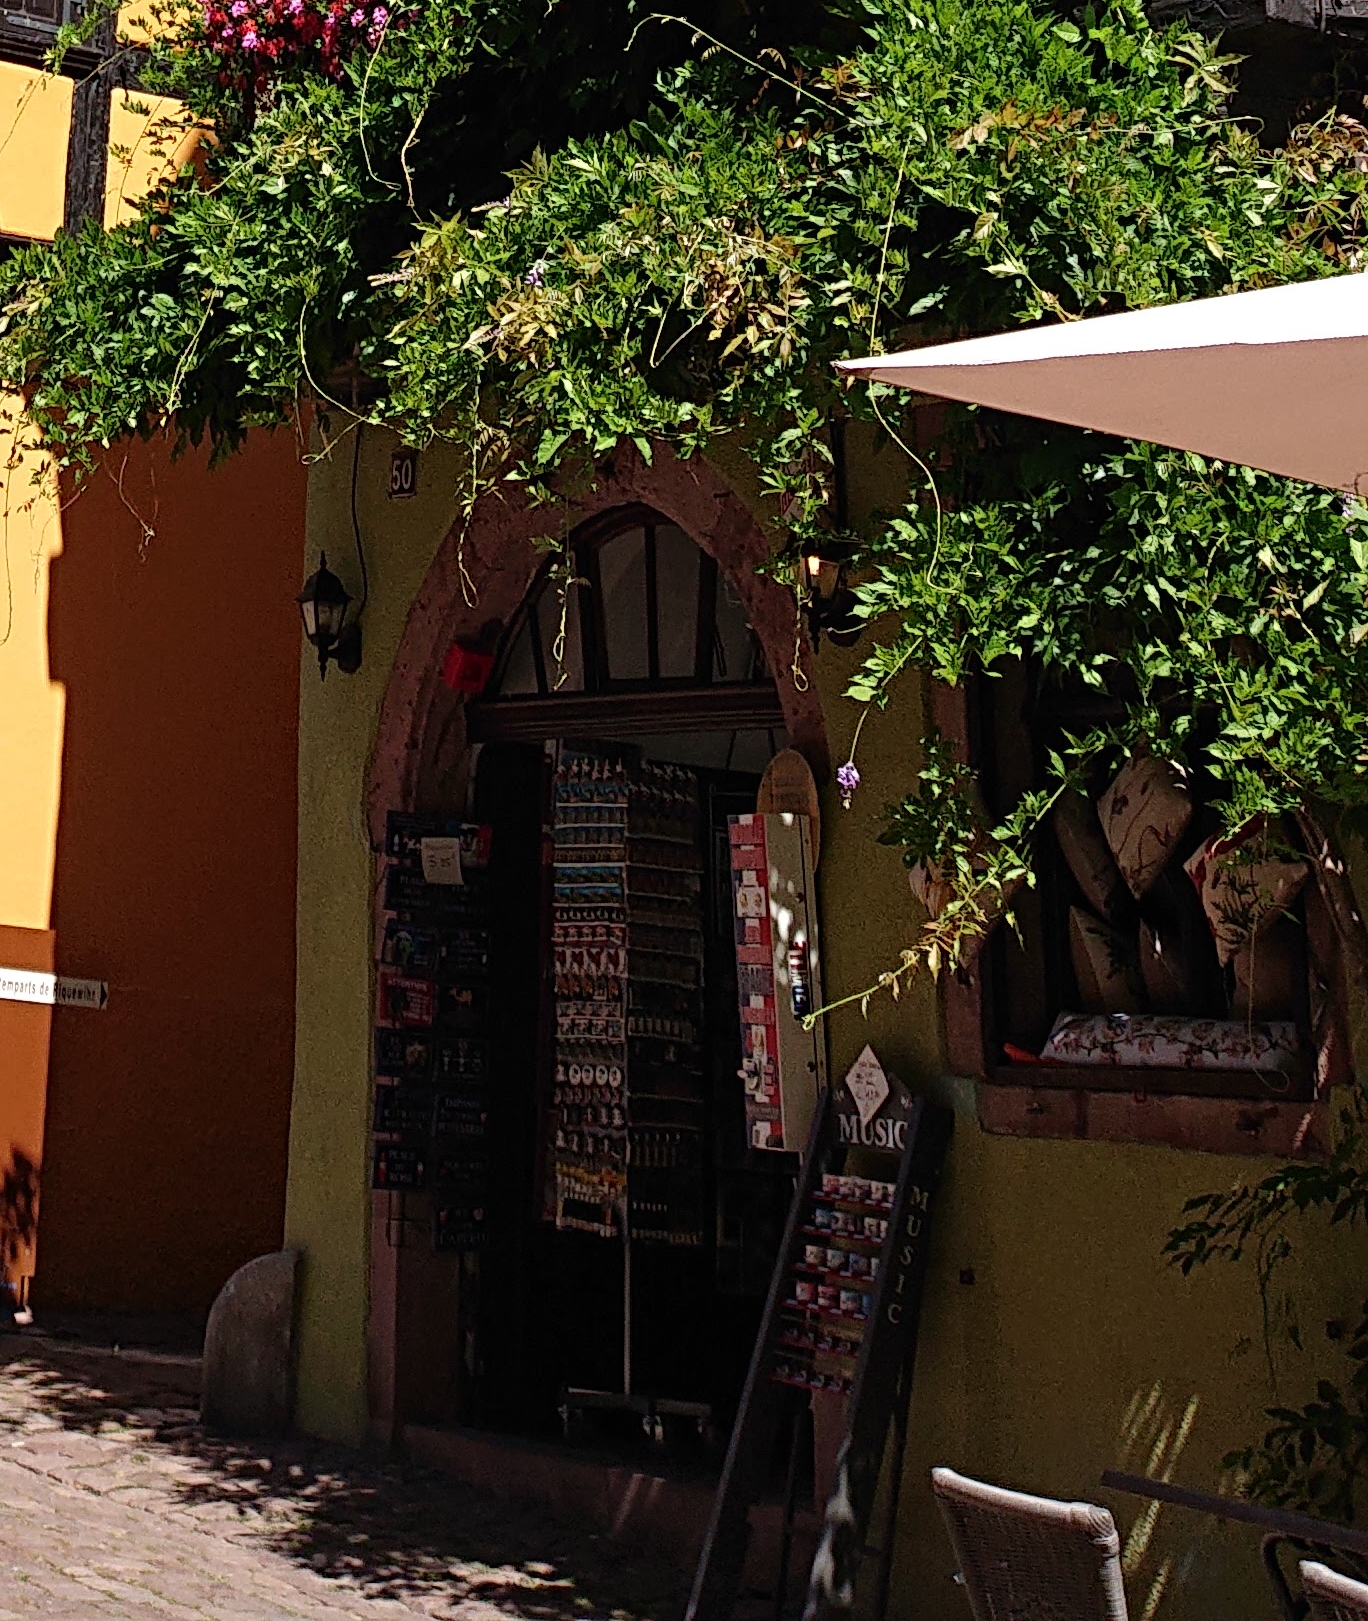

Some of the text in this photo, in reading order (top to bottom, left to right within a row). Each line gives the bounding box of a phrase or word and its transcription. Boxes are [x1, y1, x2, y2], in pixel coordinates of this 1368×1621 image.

[39, 982, 49, 996] de
[838, 1113, 909, 1150] MUSIC
[887, 1184, 930, 1325] MUSIC
